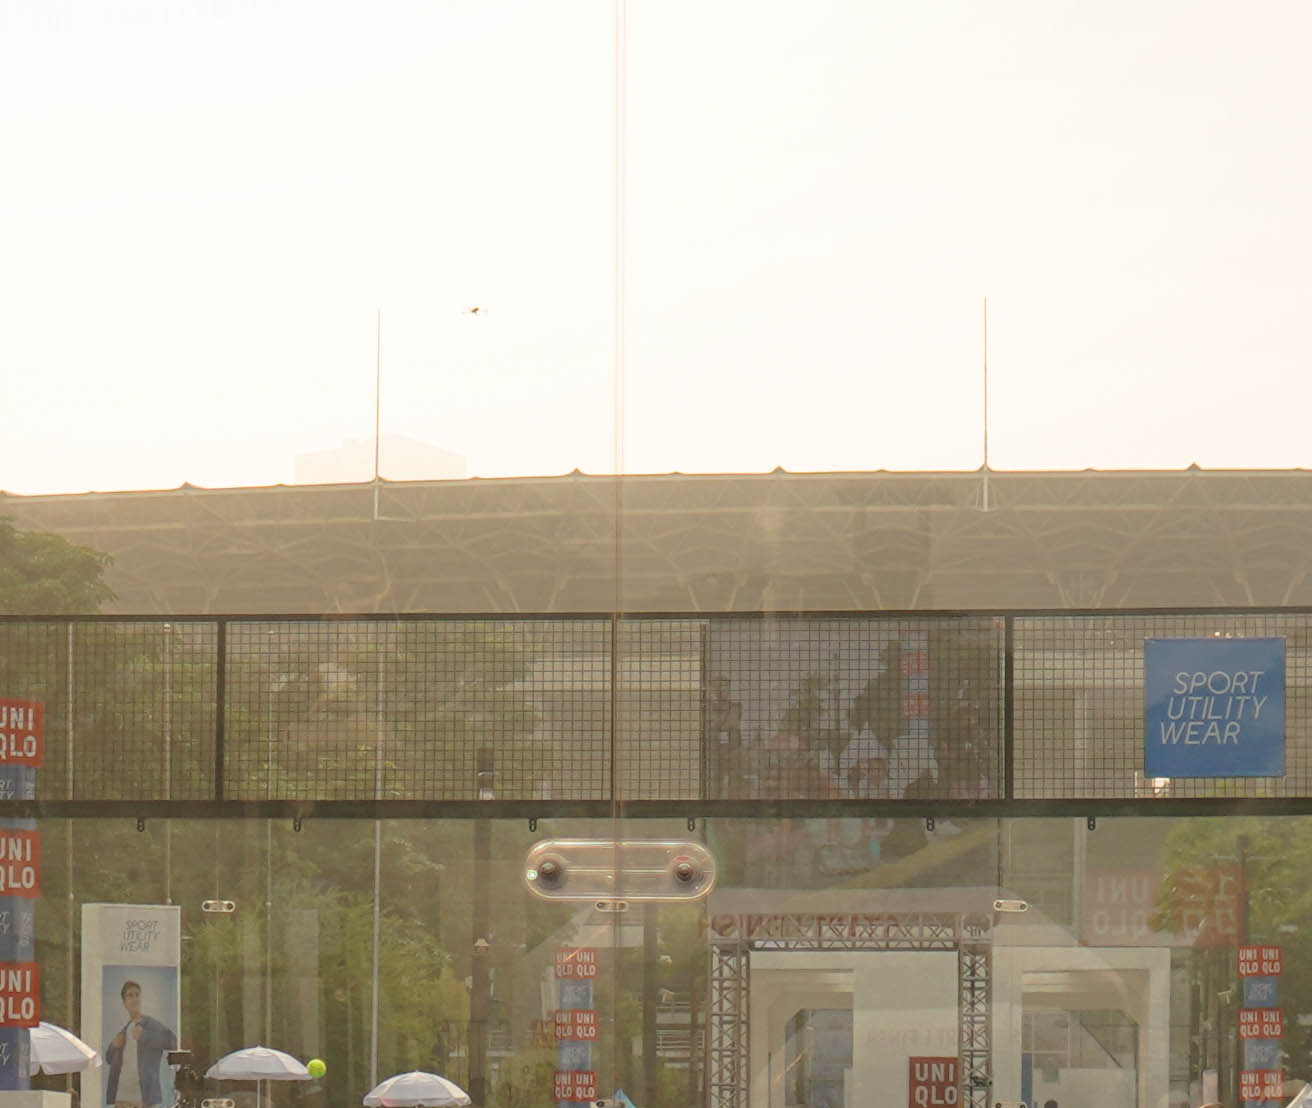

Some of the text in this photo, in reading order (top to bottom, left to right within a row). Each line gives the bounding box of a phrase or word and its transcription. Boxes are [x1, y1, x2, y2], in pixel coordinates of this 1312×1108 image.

[1172, 670, 1265, 695] SPORT
[1167, 695, 1268, 721] UTILITY
[1160, 720, 1241, 745] WEAR
[576, 950, 595, 962] UNI
[1262, 948, 1279, 960] UNI
[576, 963, 596, 976] QLO
[1261, 961, 1281, 975] QLO
[576, 1011, 594, 1024] UNI
[1263, 1010, 1280, 1023] UNI
[576, 1025, 596, 1038] QLO
[1263, 1023, 1281, 1036] QLO
[576, 1073, 593, 1085] UNI
[915, 1063, 955, 1082] UNI
[1264, 1072, 1282, 1085] UNI
[576, 1086, 595, 1099] QLO
[915, 1085, 958, 1108] QLO
[1264, 1085, 1282, 1099] QLO
